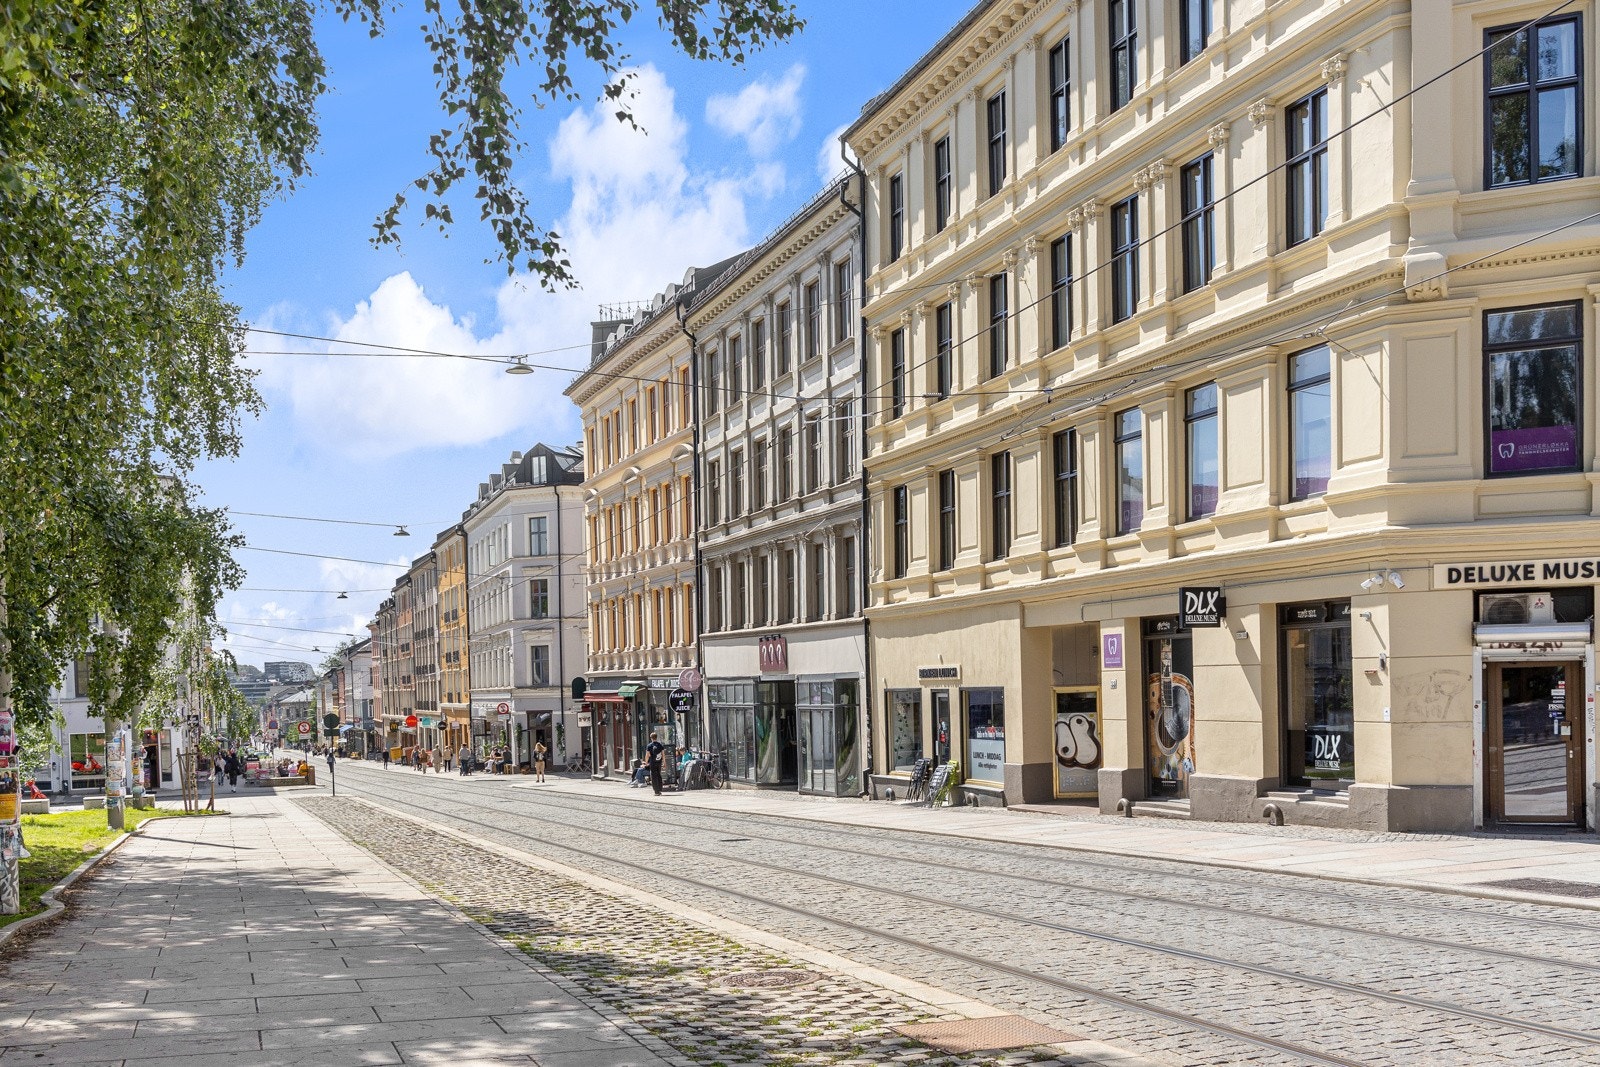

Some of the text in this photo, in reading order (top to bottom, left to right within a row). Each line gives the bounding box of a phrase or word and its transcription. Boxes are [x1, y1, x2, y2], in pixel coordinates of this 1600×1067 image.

[1447, 563, 1536, 584] DELUXE
[1185, 590, 1219, 614] DLX
[1185, 614, 1204, 622] DELUXE
[972, 751, 985, 760] LUNCH
[1314, 734, 1341, 760] DLX
